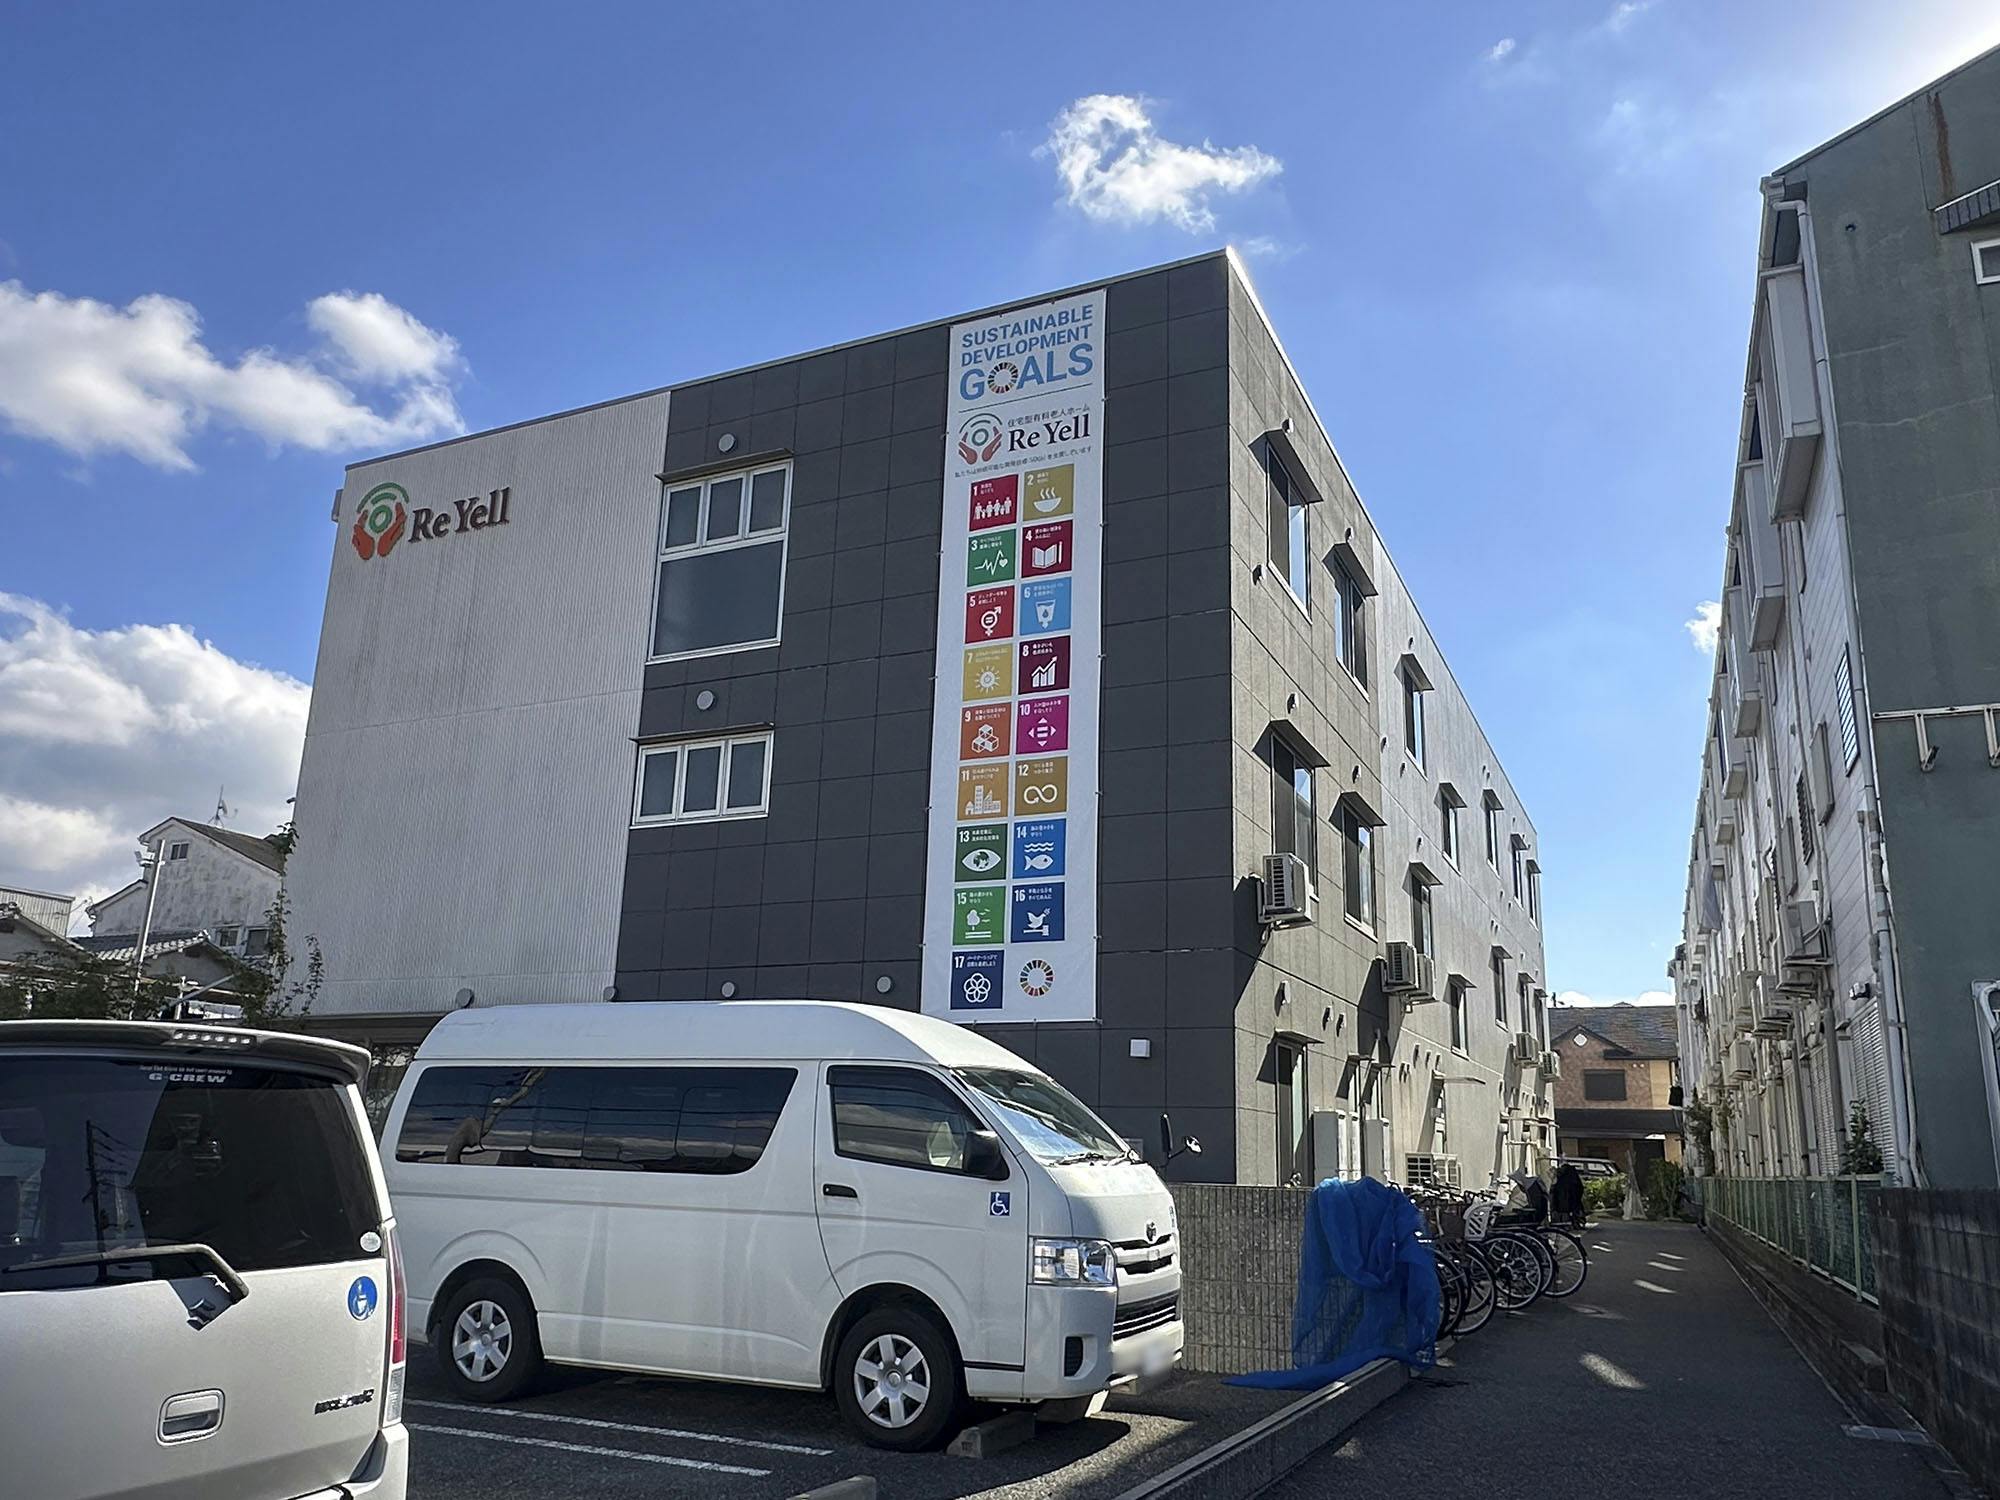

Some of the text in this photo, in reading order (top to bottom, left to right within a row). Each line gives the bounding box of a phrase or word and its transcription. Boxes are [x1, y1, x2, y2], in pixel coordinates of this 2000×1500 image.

[962, 304, 1093, 348] SUSTAINABLE
[961, 323, 1093, 367] DEVELOPMENT
[959, 342, 1093, 401] GOALS
[1008, 413, 1091, 452] Re Yell
[1027, 474, 1034, 486] 2
[973, 485, 978, 496] 1
[408, 486, 510, 543] Re Yell
[1025, 530, 1033, 541] 4
[971, 540, 978, 551] 3
[1024, 587, 1031, 598] 6
[969, 595, 976, 607] 5
[1022, 645, 1029, 657] 8
[967, 652, 973, 663] 7
[1020, 703, 1031, 716] 10
[964, 710, 971, 722] 9
[961, 769, 970, 782] 11
[1018, 764, 1029, 776] 12
[959, 830, 970, 843] 13
[1016, 826, 1027, 838] 14
[956, 892, 967, 905] 15
[1014, 889, 1026, 902] 16
[954, 955, 965, 969] 17
